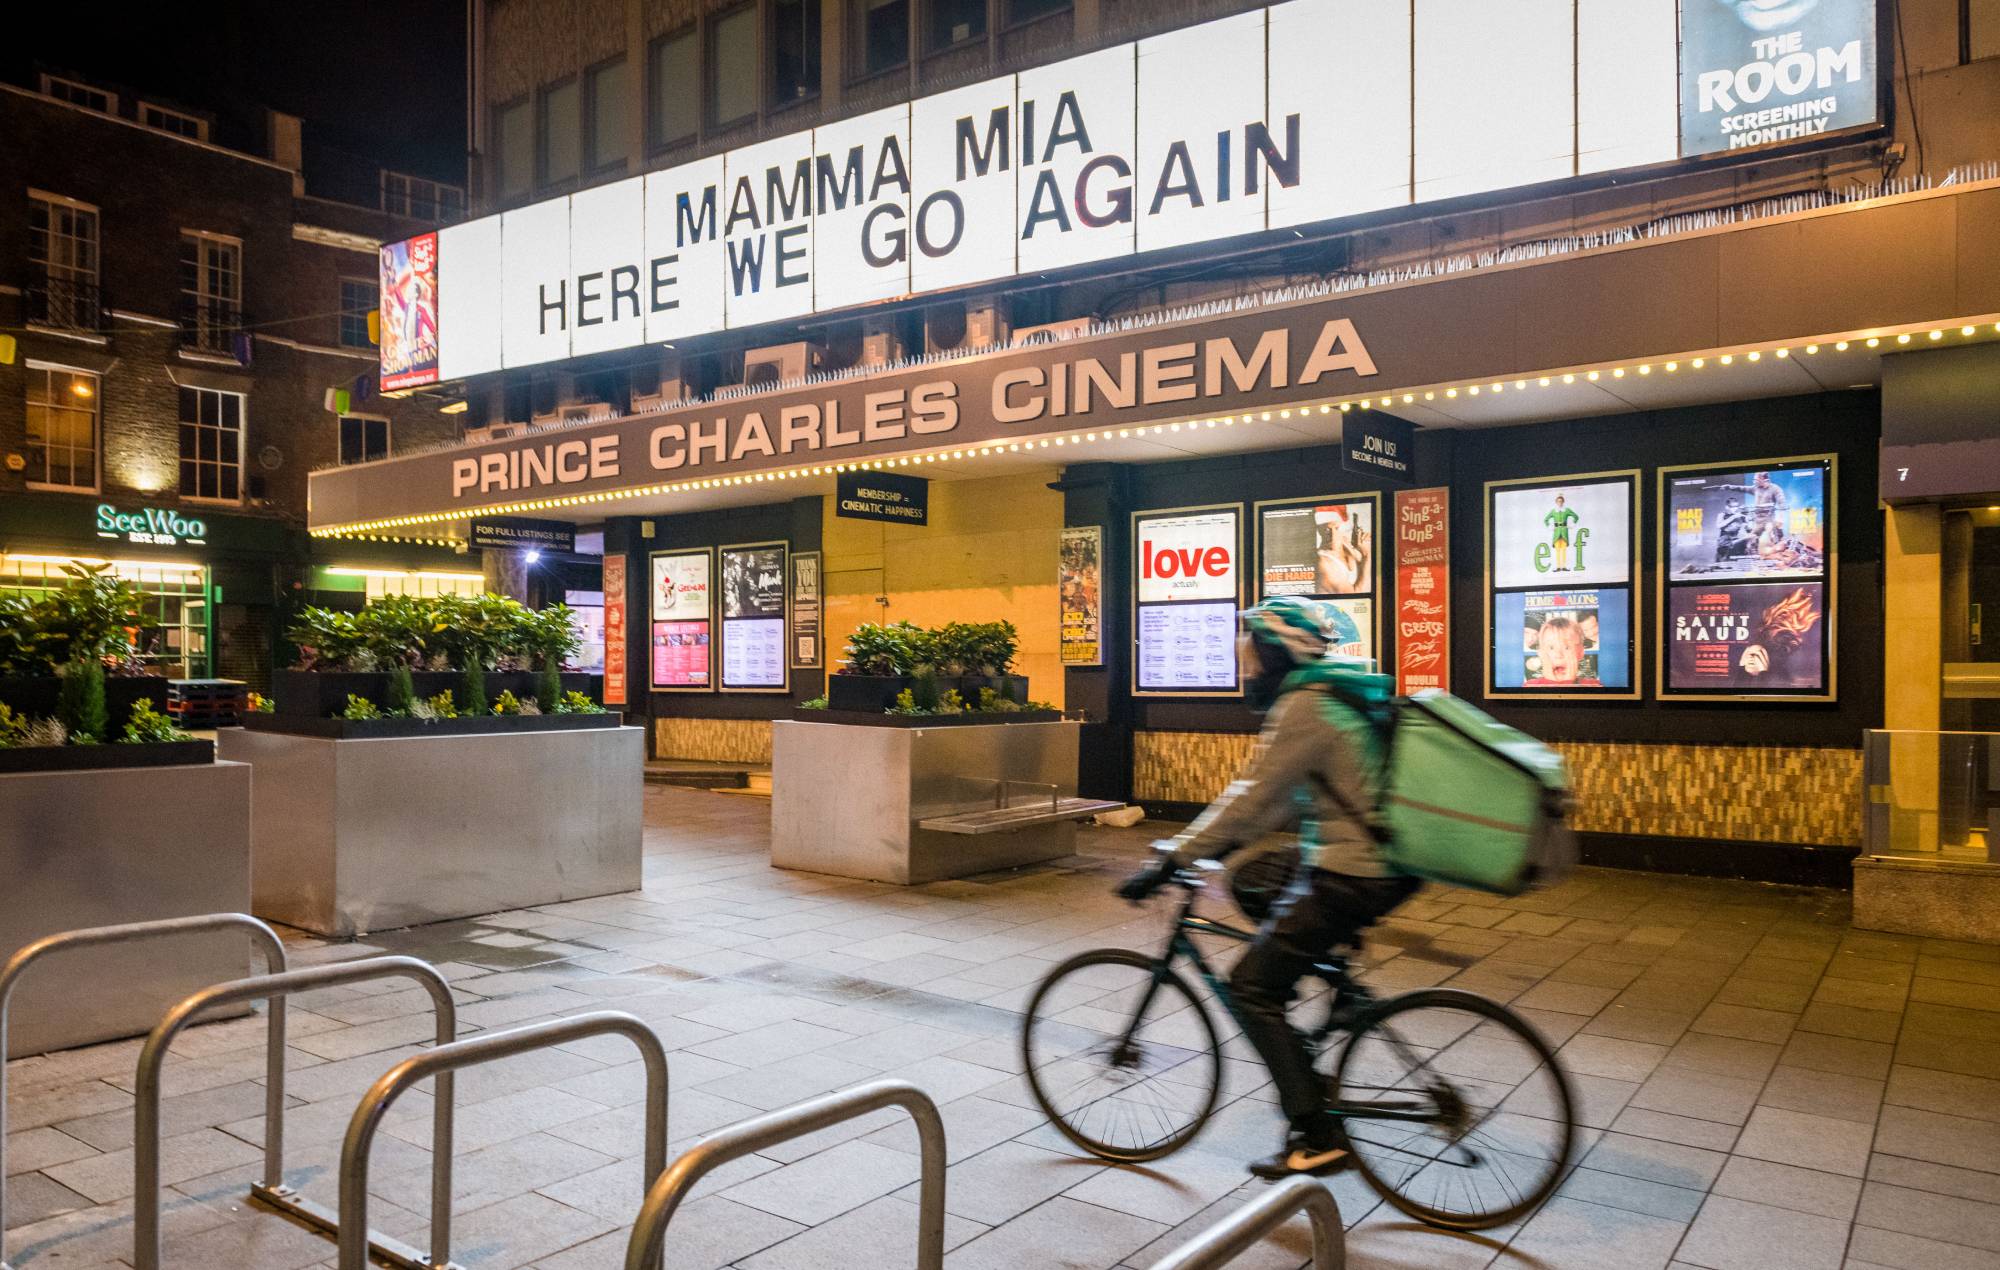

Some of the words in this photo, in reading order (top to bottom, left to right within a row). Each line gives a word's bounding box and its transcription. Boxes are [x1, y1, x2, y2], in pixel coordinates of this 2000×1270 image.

[1752, 31, 1802, 60] THE
[1697, 40, 1860, 113] ROOM
[1720, 97, 1836, 134] SCREENING
[1729, 117, 1828, 150] MONTHLY
[676, 135, 910, 248] MAMMA
[955, 90, 1093, 182] MIA
[539, 254, 680, 335] HERE
[727, 224, 809, 297] WE
[861, 190, 965, 268] GO
[1021, 113, 1300, 241] AGAIN
[453, 434, 620, 497] PRINCE
[649, 380, 960, 471] CHARLES
[991, 318, 1379, 423] CINEMA
[1363, 434, 1383, 454] JOIN
[1897, 468, 1909, 481] 7
[857, 488, 902, 502] MEMBERSHIP
[841, 500, 883, 513] CINEMATIC
[884, 505, 923, 518] HAPPINESS
[1401, 503, 1444, 525] Sing-a-
[476, 525, 495, 535] FOR
[495, 527, 516, 537] FULL
[517, 529, 554, 540] LISTINGS
[554, 532, 571, 541] SEE
[1401, 520, 1443, 543] Long-a
[1143, 540, 1230, 579] love
[1263, 572, 1284, 581] DIE
[1284, 571, 1315, 581] HARD
[1525, 595, 1553, 606] HOME
[1676, 615, 1750, 627] SAINT
[1676, 627, 1750, 641] MAUD
